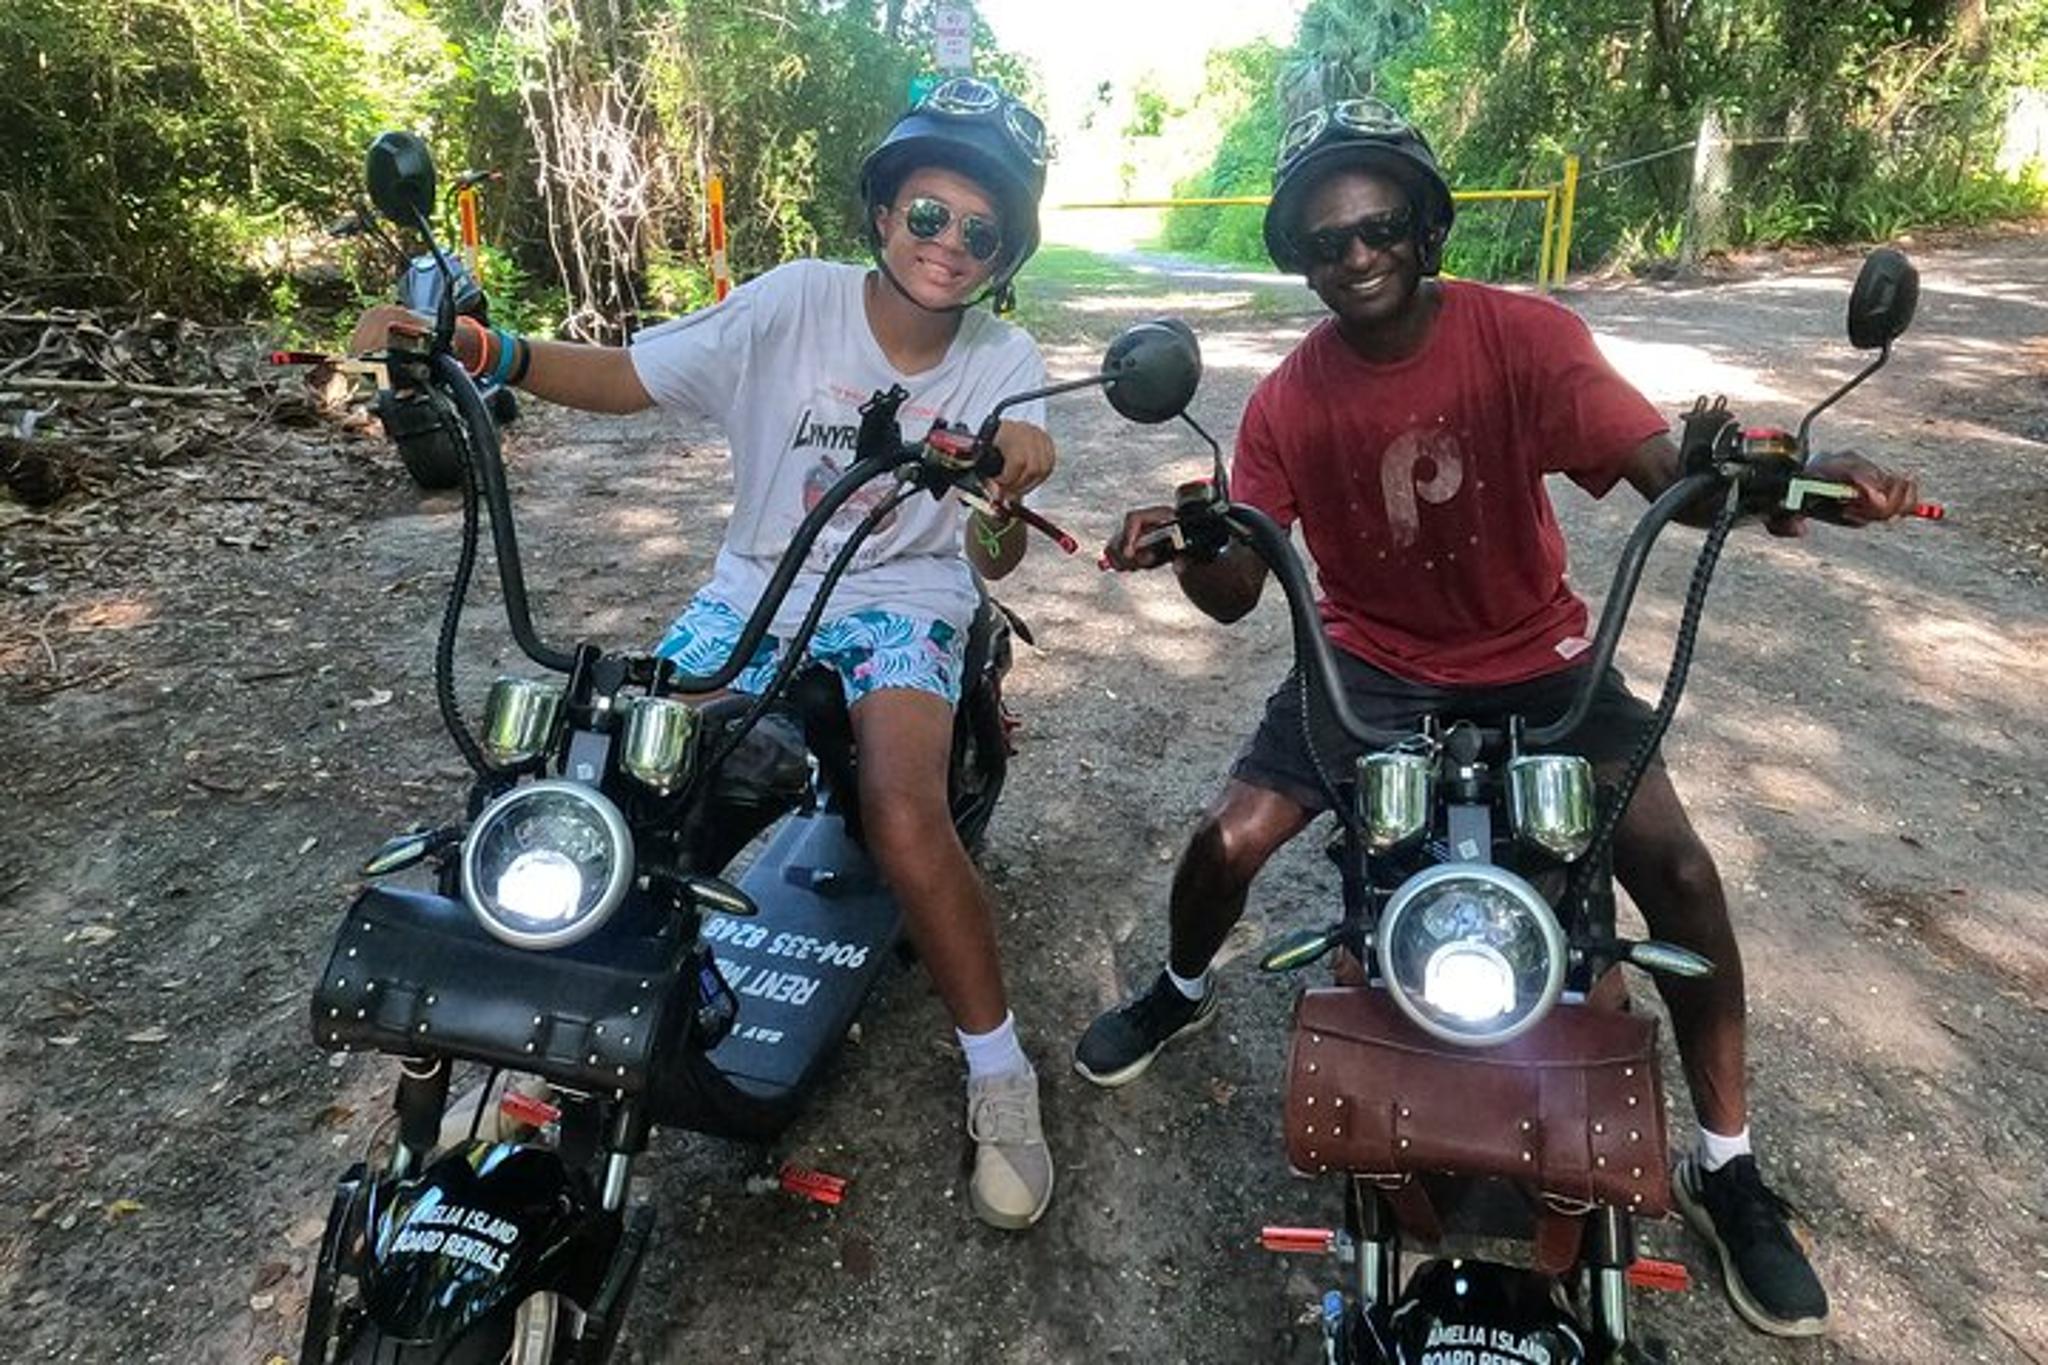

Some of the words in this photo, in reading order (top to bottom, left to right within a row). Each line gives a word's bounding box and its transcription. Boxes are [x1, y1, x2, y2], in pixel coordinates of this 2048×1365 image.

[792, 408, 860, 450] LYNYR
[766, 932, 869, 969] 904-335
[741, 968, 820, 1005] RENT
[463, 1209, 519, 1244] ISLAND
[440, 1233, 510, 1274] RENTALS
[1425, 1324, 1487, 1348] AMELIA
[1490, 1328, 1551, 1364] ISLAND
